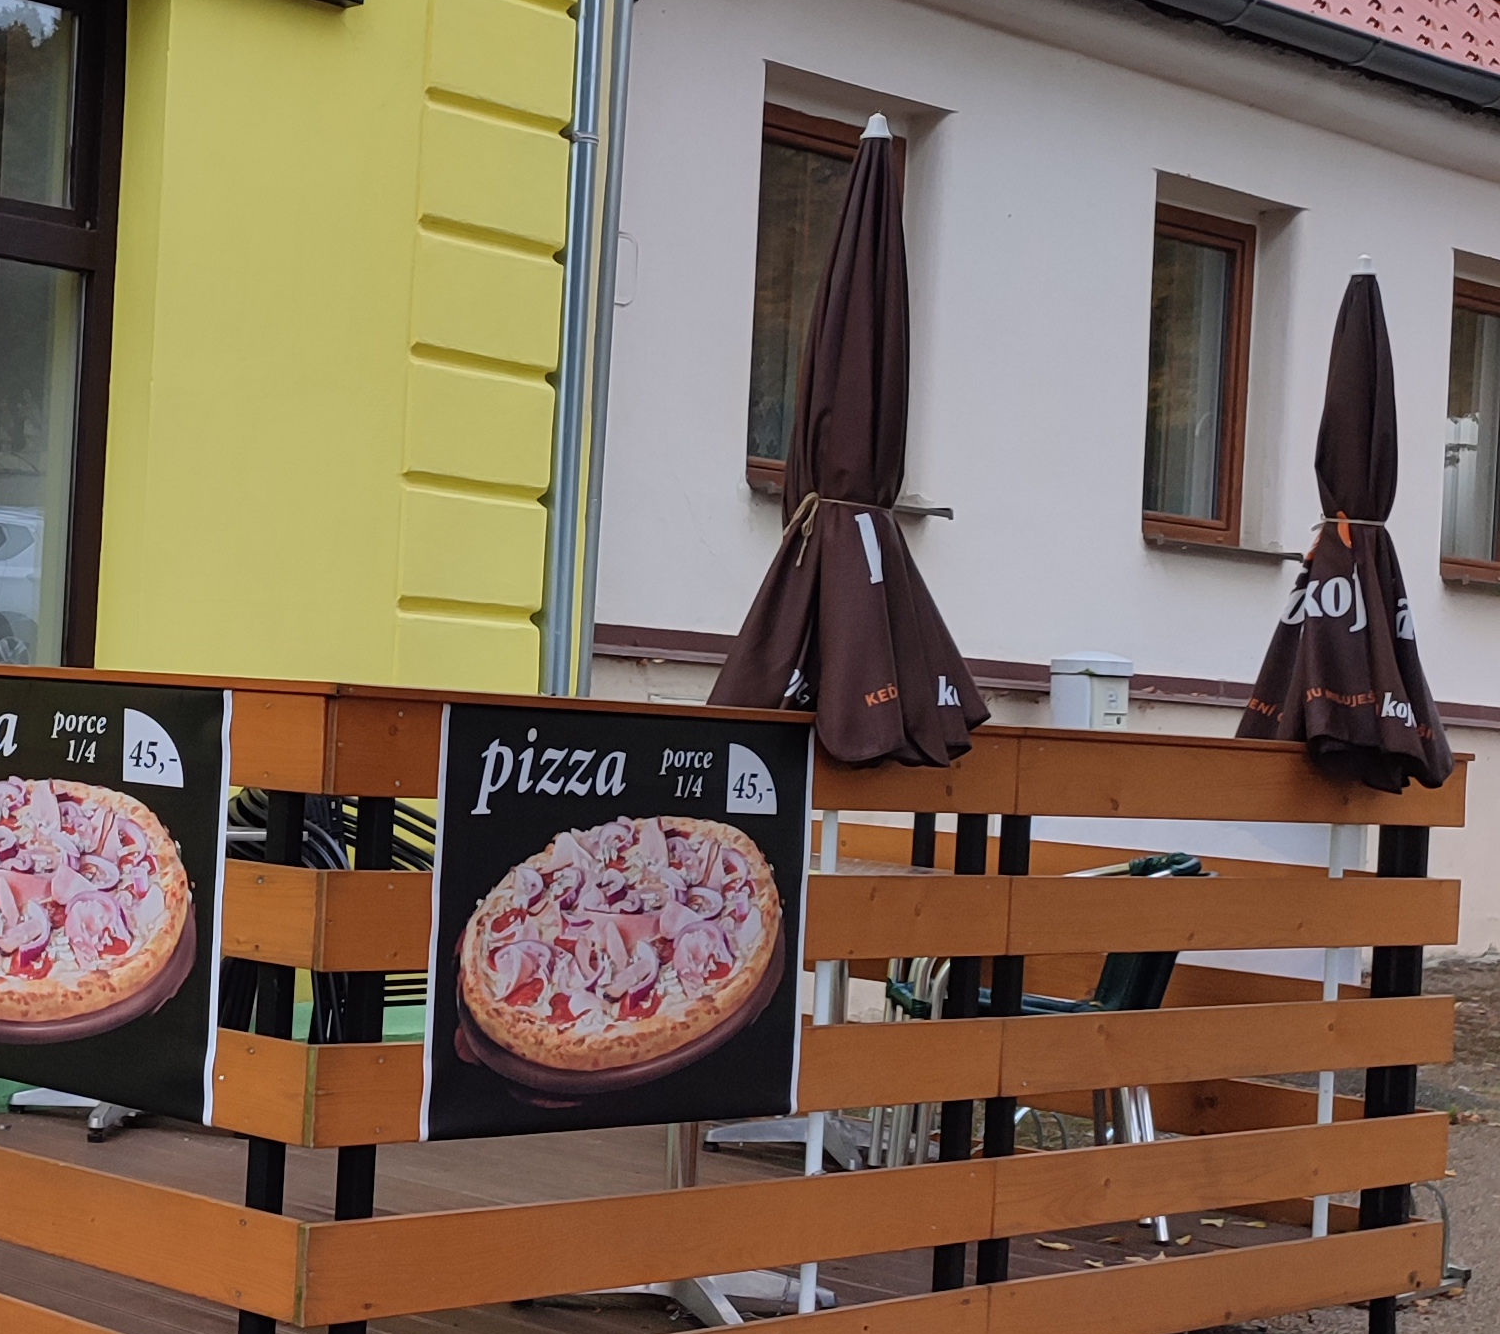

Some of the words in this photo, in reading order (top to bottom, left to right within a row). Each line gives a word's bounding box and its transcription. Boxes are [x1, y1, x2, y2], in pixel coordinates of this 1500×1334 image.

[51, 709, 108, 738] porce
[65, 739, 97, 764] 1/4
[128, 738, 179, 775] 45,-
[659, 746, 714, 775] porce
[470, 727, 628, 815] pizza
[674, 775, 704, 799] 1/4
[732, 772, 774, 804] 45,-
